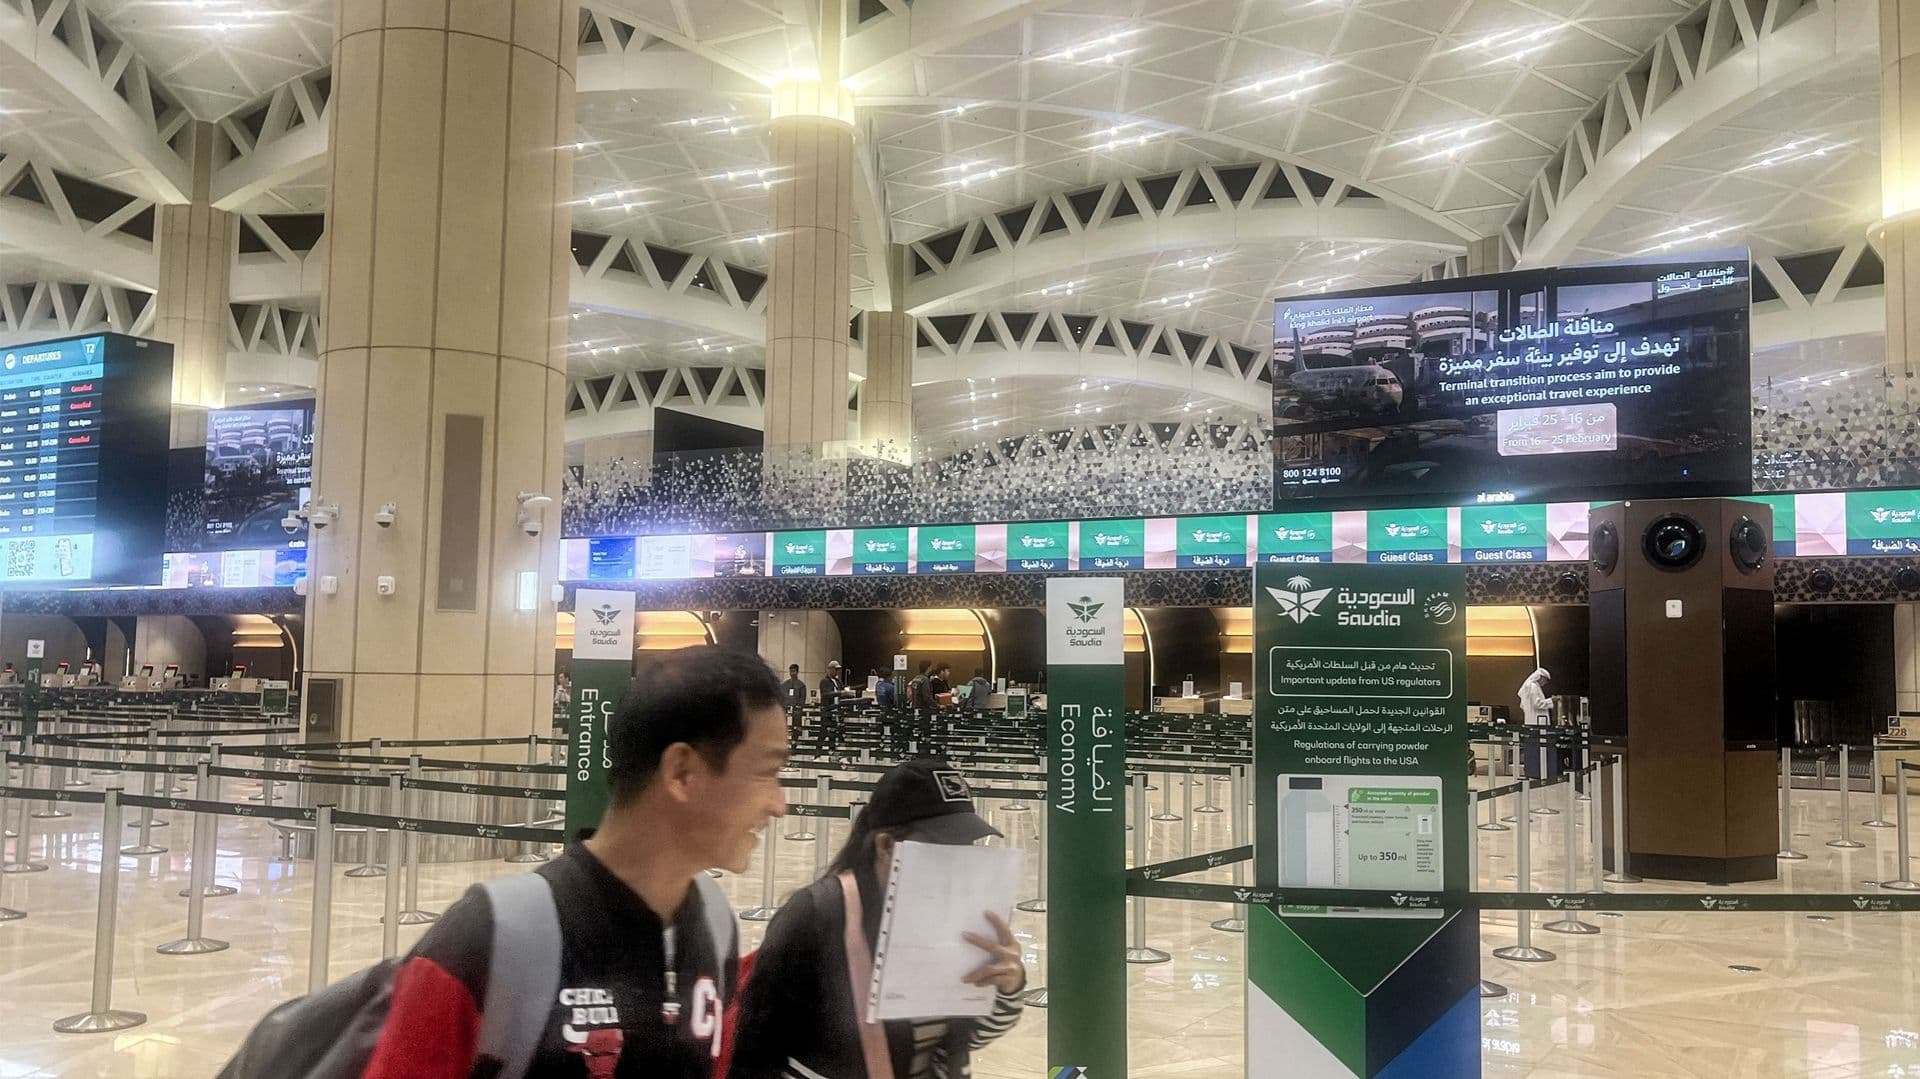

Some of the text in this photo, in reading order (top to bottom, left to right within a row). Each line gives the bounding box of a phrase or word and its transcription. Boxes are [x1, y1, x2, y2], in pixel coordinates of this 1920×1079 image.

[1347, 314, 1373, 326] airport
[1499, 316, 1615, 342] مناقلة الصالات
[86, 344, 96, 353] T2
[1439, 337, 1680, 375] تهدف إلى توفير بيئة سفر مميزة
[1439, 363, 1681, 392] Terminal transition process aim to provide
[1465, 384, 1652, 406] an exceptional travel experience
[1508, 413, 1605, 431] من 16 25 فبراير
[1503, 432, 1611, 447] From 16 25 February
[1283, 466, 1341, 478] 800 124 8100
[1380, 552, 1433, 562] Guest Class
[1475, 549, 1533, 560] Guest Class
[1338, 587, 1415, 609] السعودية
[1338, 609, 1400, 626] Saudia
[1066, 626, 1105, 638] السعودية
[592, 637, 618, 645] Saudia
[1069, 637, 1102, 646] Saudia
[1286, 657, 1436, 672] تحديث هام من قبل السلطات الأمريكية
[1281, 676, 1441, 688] Important update from US regulators
[1278, 705, 1445, 717] القوانين الجديدة لحمل المساحيق على متن
[1270, 718, 1453, 734] الرحلات المتجهة إلى الولايات المتحدة الأمريكية
[577, 688, 598, 782] Entrance
[1294, 740, 1429, 752] Regulations of carrying powder
[1056, 704, 1081, 813] Economy
[1087, 706, 1113, 812] الضيافة
[1305, 755, 1419, 766] onboard flights to the USA
[1358, 854, 1369, 862] Up
[1379, 852, 1398, 861] 350
